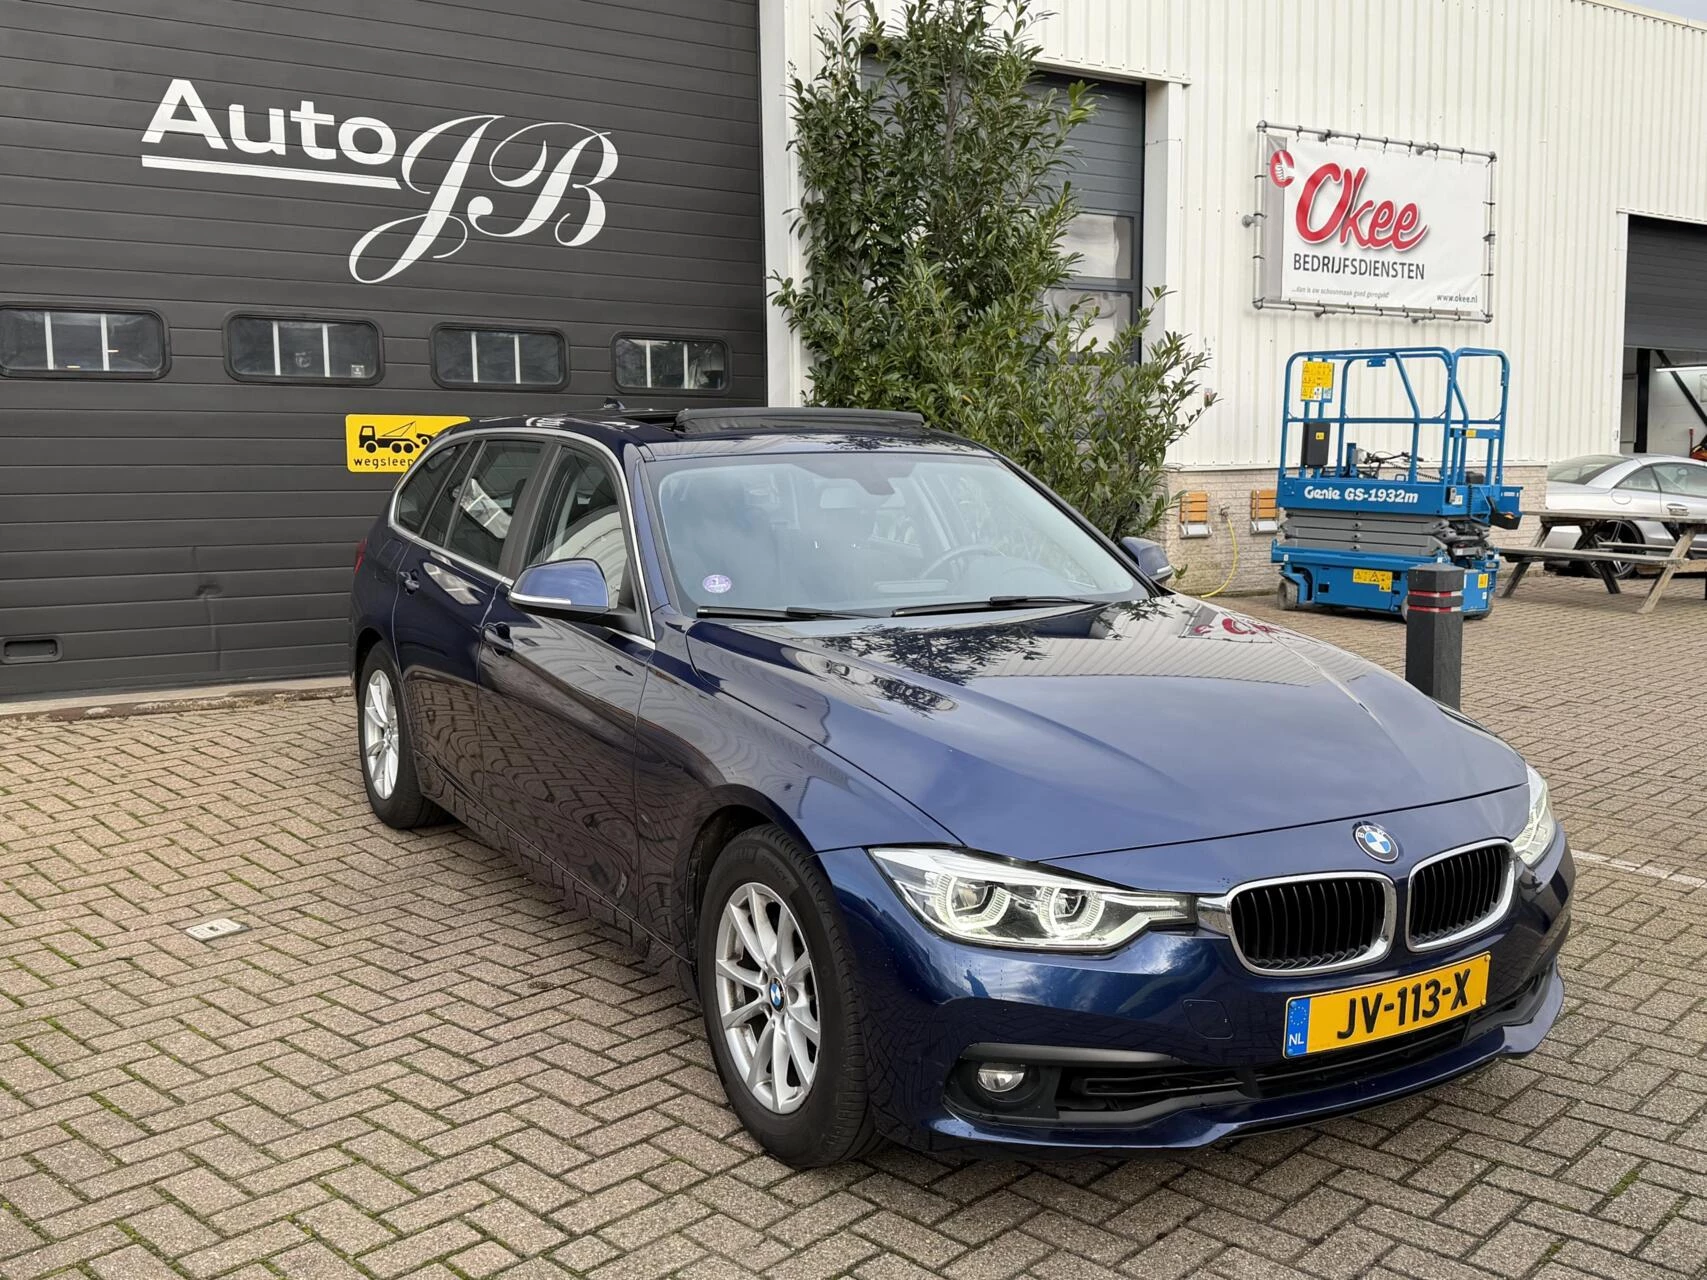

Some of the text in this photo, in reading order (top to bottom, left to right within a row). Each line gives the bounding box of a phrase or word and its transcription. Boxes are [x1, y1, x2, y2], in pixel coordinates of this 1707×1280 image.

[141, 78, 619, 283] Auto JB
[1295, 163, 1429, 251] Okee
[1293, 253, 1425, 280] BEDRIJFSDIENSTEN
[1304, 486, 1419, 503] Genie GS-1932m
[1337, 968, 1471, 1039] JV-113-X
[1288, 1033, 1304, 1046] NL
